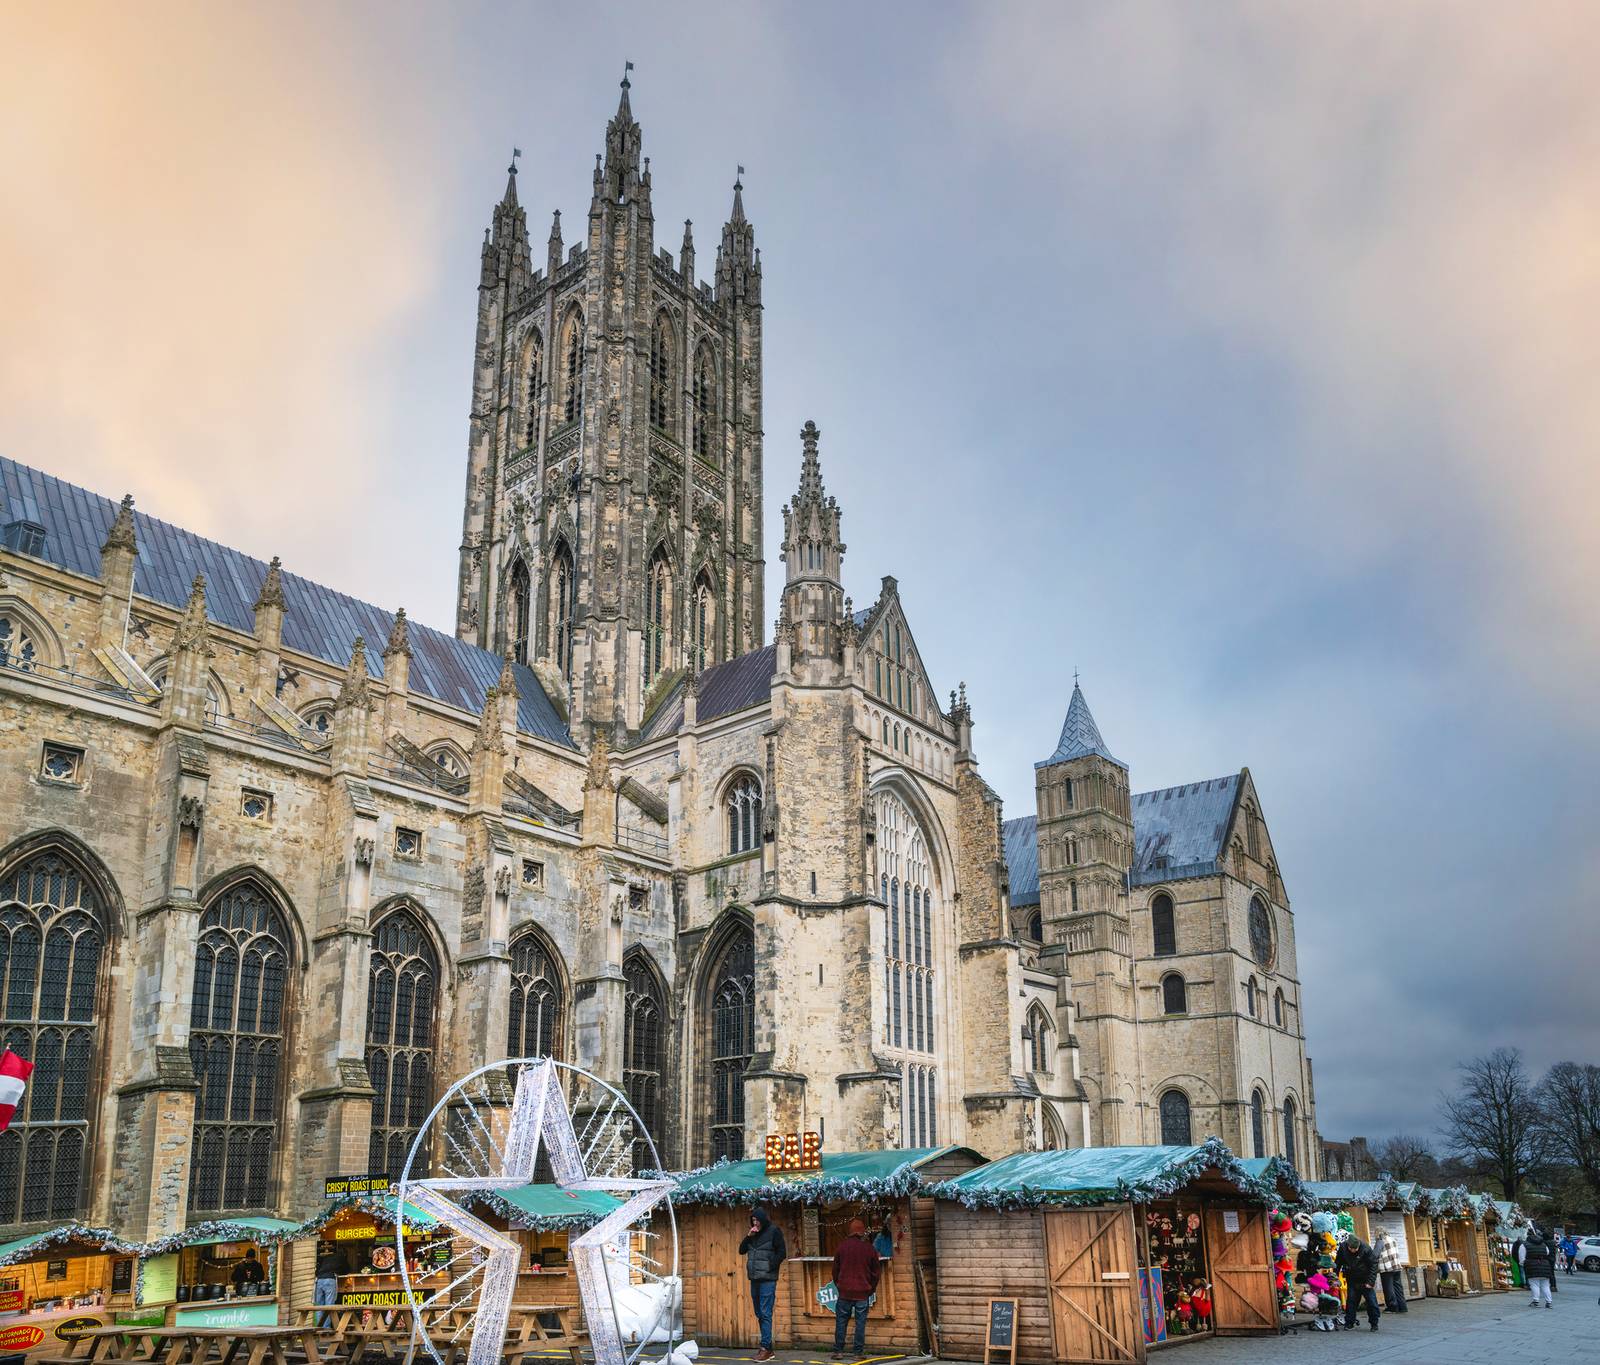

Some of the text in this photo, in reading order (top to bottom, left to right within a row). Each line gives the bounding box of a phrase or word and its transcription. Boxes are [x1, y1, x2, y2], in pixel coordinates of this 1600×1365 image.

[766, 1132, 821, 1171] BAR
[326, 1179, 388, 1193] CRISPY ROAST DUCK
[335, 1226, 376, 1240] BURGERS
[342, 1293, 372, 1306] CRISPY
[373, 1292, 400, 1306] ROAST
[0, 1327, 32, 1339] ATORNADO
